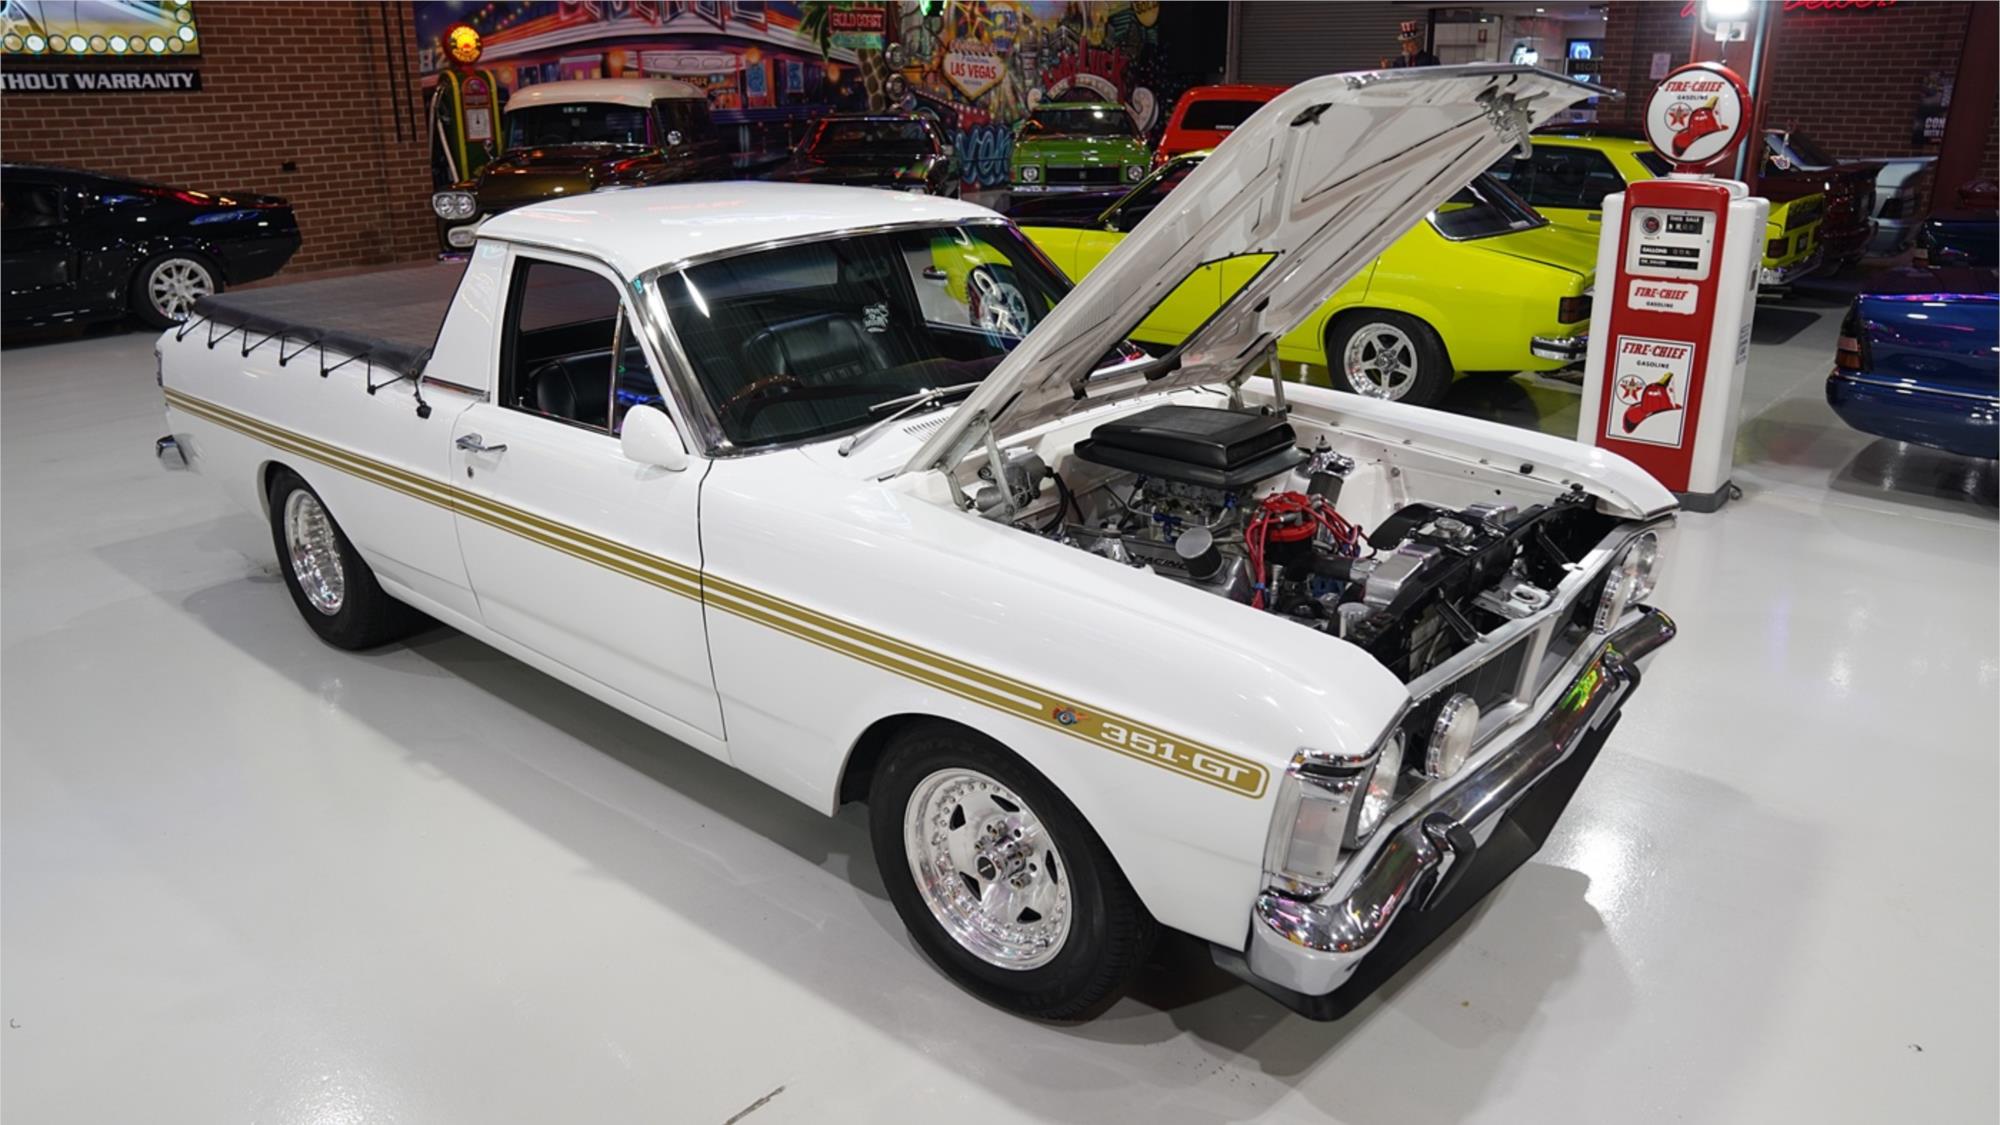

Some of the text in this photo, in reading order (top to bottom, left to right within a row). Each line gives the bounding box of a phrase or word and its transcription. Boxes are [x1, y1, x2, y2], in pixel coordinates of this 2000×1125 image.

[950, 61, 997, 80] LAS VEGAS
[73, 72, 194, 90] WARRANTY
[1664, 81, 1726, 93] FIRE-CHIEF
[1634, 286, 1688, 300] FIRE-CHIEF
[1622, 342, 1688, 359] FIRE-CHIEF
[1636, 360, 1669, 369] GASOLINE
[1100, 721, 1251, 782] 351-GT
